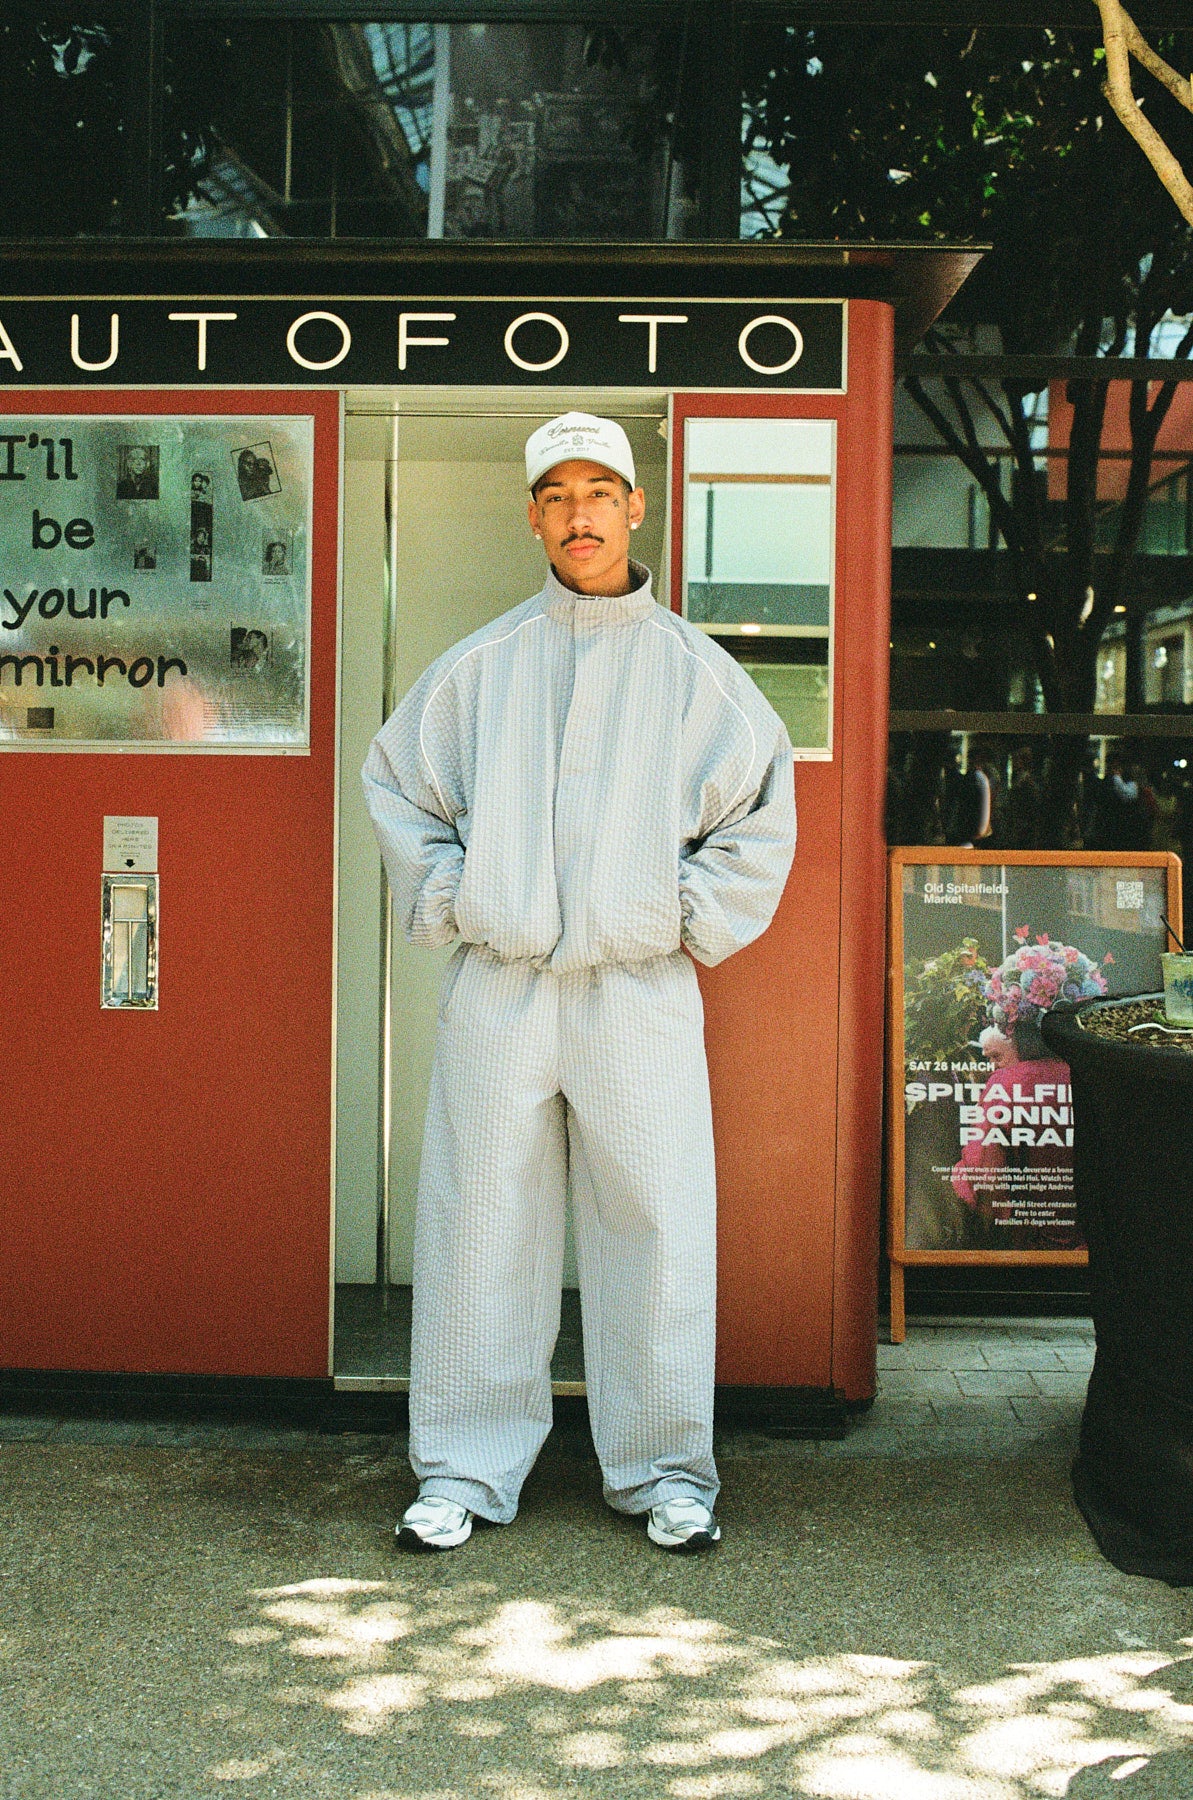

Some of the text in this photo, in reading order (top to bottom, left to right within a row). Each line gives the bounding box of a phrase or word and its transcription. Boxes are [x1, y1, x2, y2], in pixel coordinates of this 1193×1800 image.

[0, 433, 78, 480] I'll
[32, 509, 95, 550] be
[2, 587, 131, 630] your
[0, 646, 188, 688] mirror
[924, 882, 1009, 895] Old Spitalfields
[924, 894, 963, 904] Market
[909, 1061, 931, 1071] SAT
[951, 1061, 995, 1071] MARCH
[905, 1083, 1073, 1103] SPITALFI
[960, 1105, 1075, 1125] BONN
[958, 1167, 974, 1176] your
[1023, 1165, 1051, 1173] decorate
[995, 1182, 1010, 1190] with
[1011, 1183, 1028, 1191] guest
[1029, 1182, 1047, 1191] judge
[1027, 1200, 1047, 1208] Street
[1014, 1209, 1029, 1217] Free
[1030, 1209, 1037, 1217] to
[994, 1218, 1023, 1226] Families
[1030, 1218, 1046, 1227] dogs
